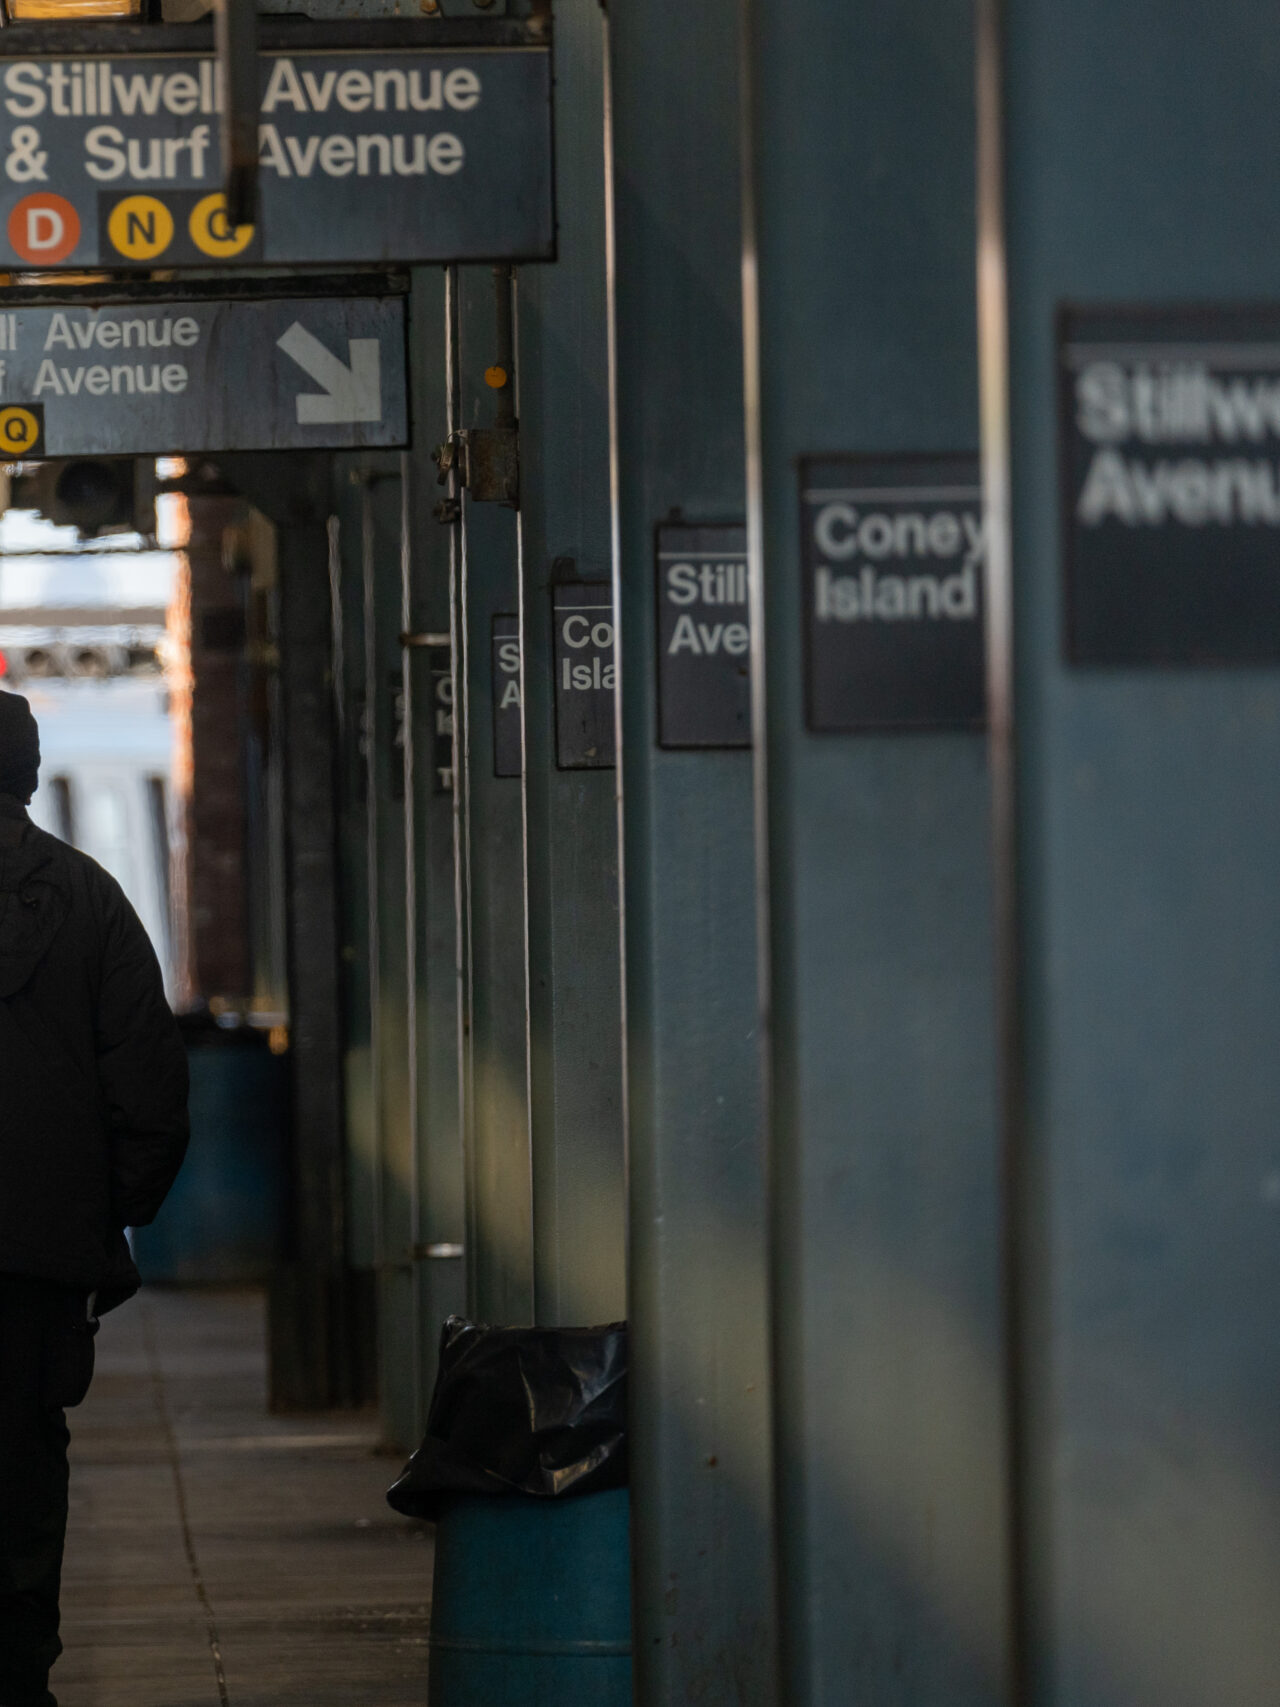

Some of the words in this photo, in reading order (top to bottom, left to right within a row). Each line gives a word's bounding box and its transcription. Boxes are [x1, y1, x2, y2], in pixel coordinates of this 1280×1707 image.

[4, 60, 224, 118] Stillwell
[260, 58, 481, 112] Avenue
[5, 125, 48, 182] &
[84, 124, 210, 180] Surf
[258, 122, 464, 177] Avenue
[27, 208, 63, 250] D
[126, 211, 156, 245] N
[45, 313, 200, 351] Avenue
[33, 358, 189, 396] Avenue
[4, 417, 29, 443] Q
[816, 503, 985, 564] Coney
[815, 565, 975, 622] Island
